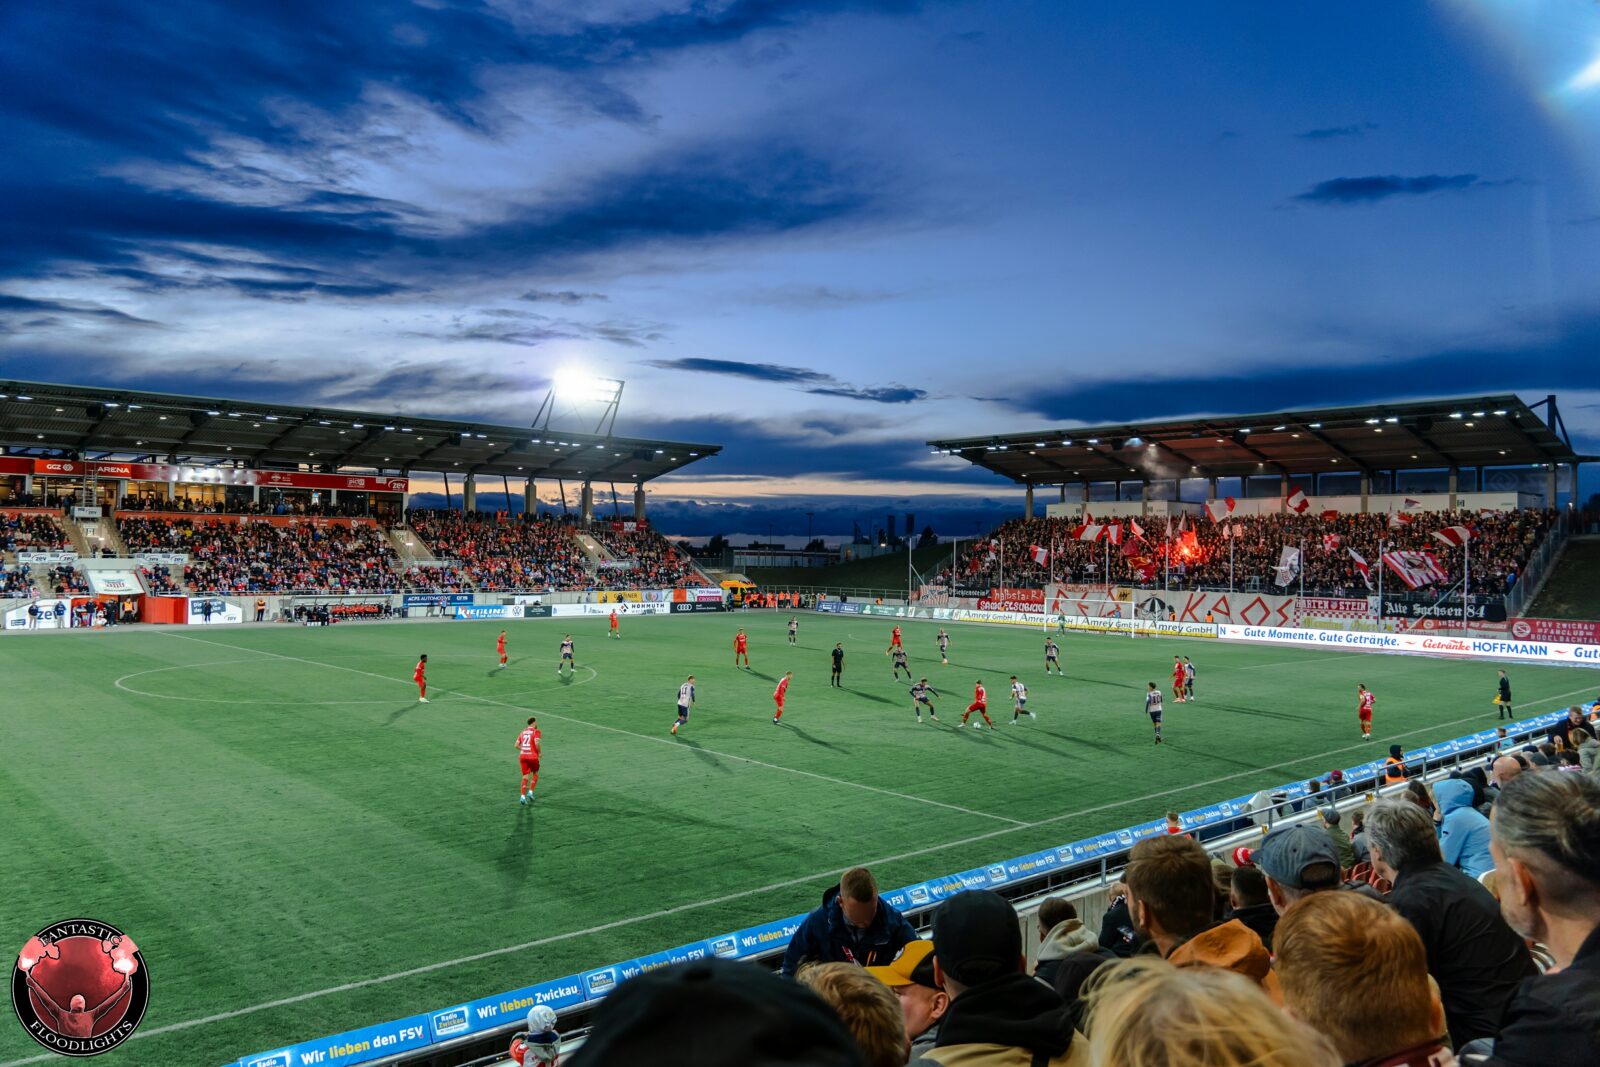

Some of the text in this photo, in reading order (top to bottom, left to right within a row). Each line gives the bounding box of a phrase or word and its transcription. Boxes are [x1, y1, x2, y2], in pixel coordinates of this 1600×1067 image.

[964, 610, 991, 619] Amrey
[1385, 602, 1408, 615] Alte
[1466, 604, 1485, 618] 84
[1020, 613, 1073, 625] Amrey GbH
[1081, 617, 1140, 629] Amrey GmbH
[1148, 620, 1213, 633] Amrey GmbH
[1244, 628, 1399, 646] Gute Momente. Gute Getränke.
[1422, 639, 1548, 655] Getränke HOFFMANN
[522, 734, 531, 746] 22
[1074, 846, 1084, 854] Wir
[1008, 866, 1019, 874] Wir
[1036, 858, 1046, 867] den
[1045, 855, 1055, 865] FSV
[931, 886, 943, 896] Wir
[963, 875, 985, 887] Zwickau
[891, 894, 904, 906] FSV
[742, 936, 757, 948] Wir
[758, 930, 783, 944] lieben
[622, 968, 640, 980] Wir
[688, 948, 705, 960] FSV
[476, 984, 578, 1019] Wir lieben Zwickau
[441, 1012, 458, 1022] Radio
[301, 1050, 326, 1065] Wir
[329, 1041, 370, 1059] lieben
[373, 1032, 396, 1048] den
[399, 1026, 423, 1042] FSV
